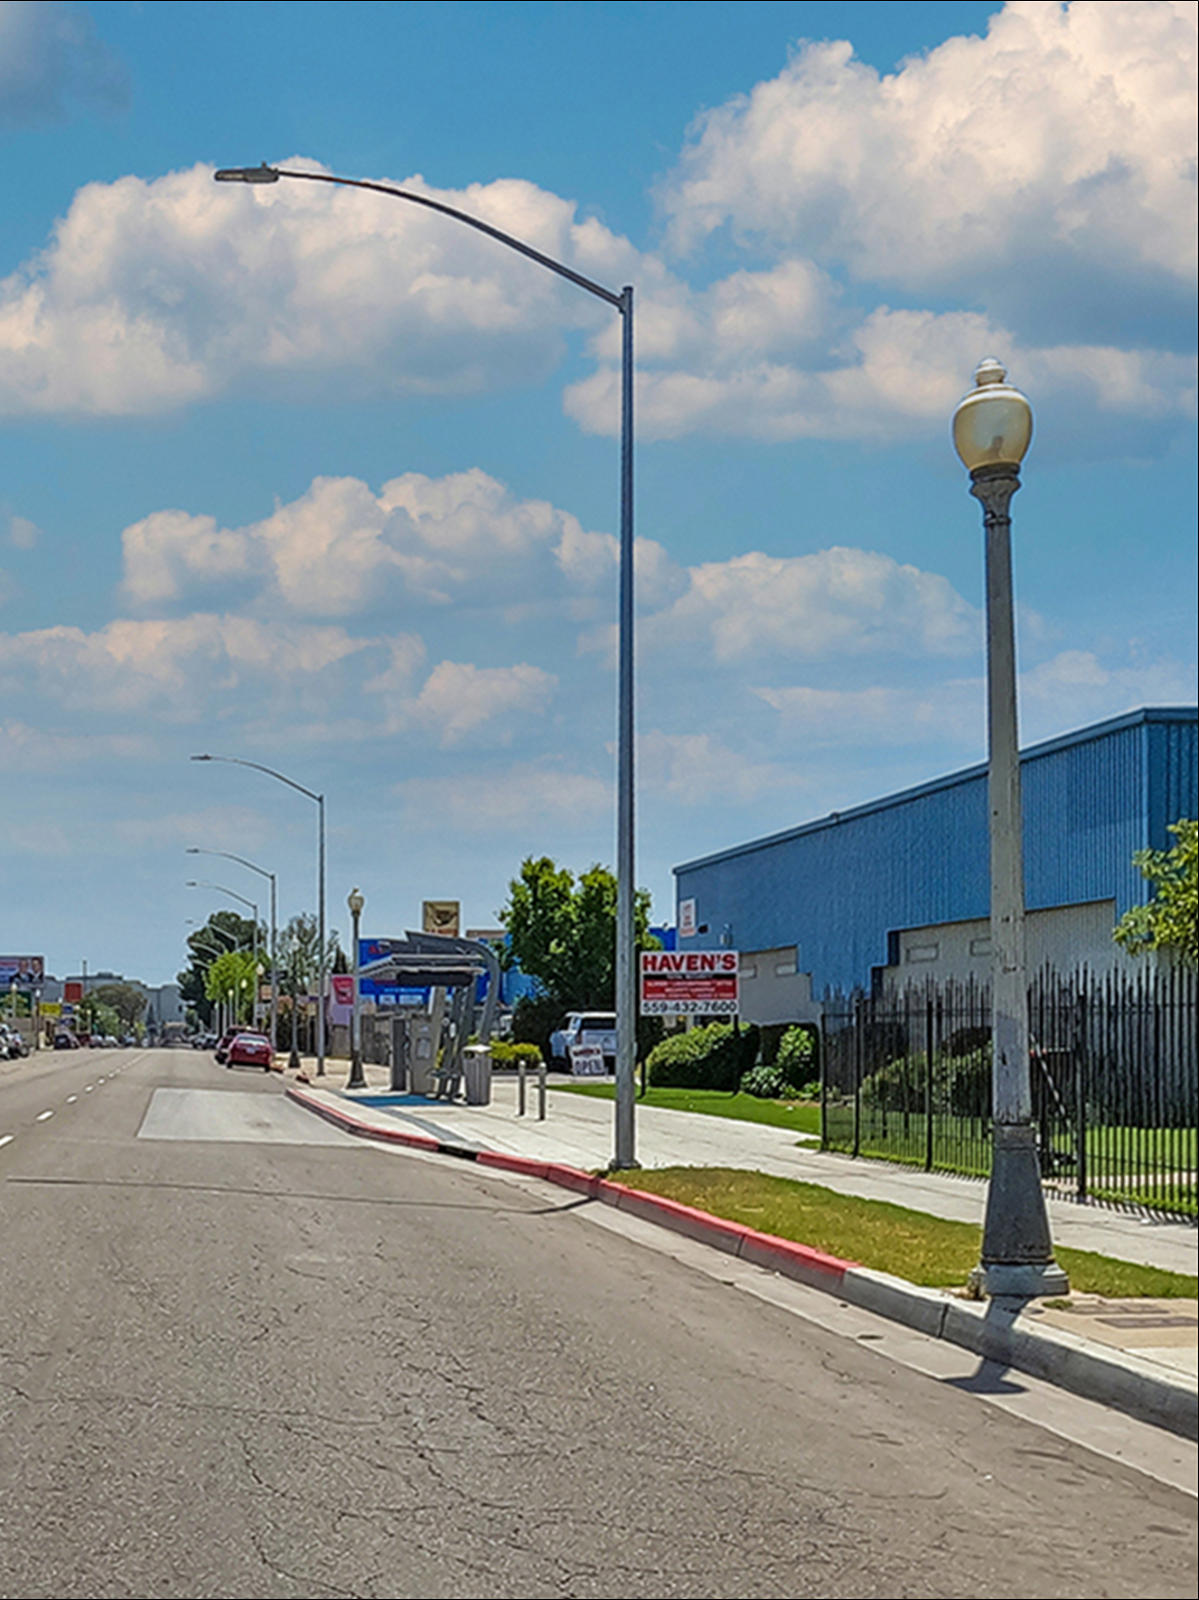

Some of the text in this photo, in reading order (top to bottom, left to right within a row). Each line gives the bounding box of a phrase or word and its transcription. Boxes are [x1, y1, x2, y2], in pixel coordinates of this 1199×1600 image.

[643, 953, 737, 971] HAVEN'S
[643, 1001, 738, 1013] 559-432-7600
[574, 1059, 606, 1076] OPEN
